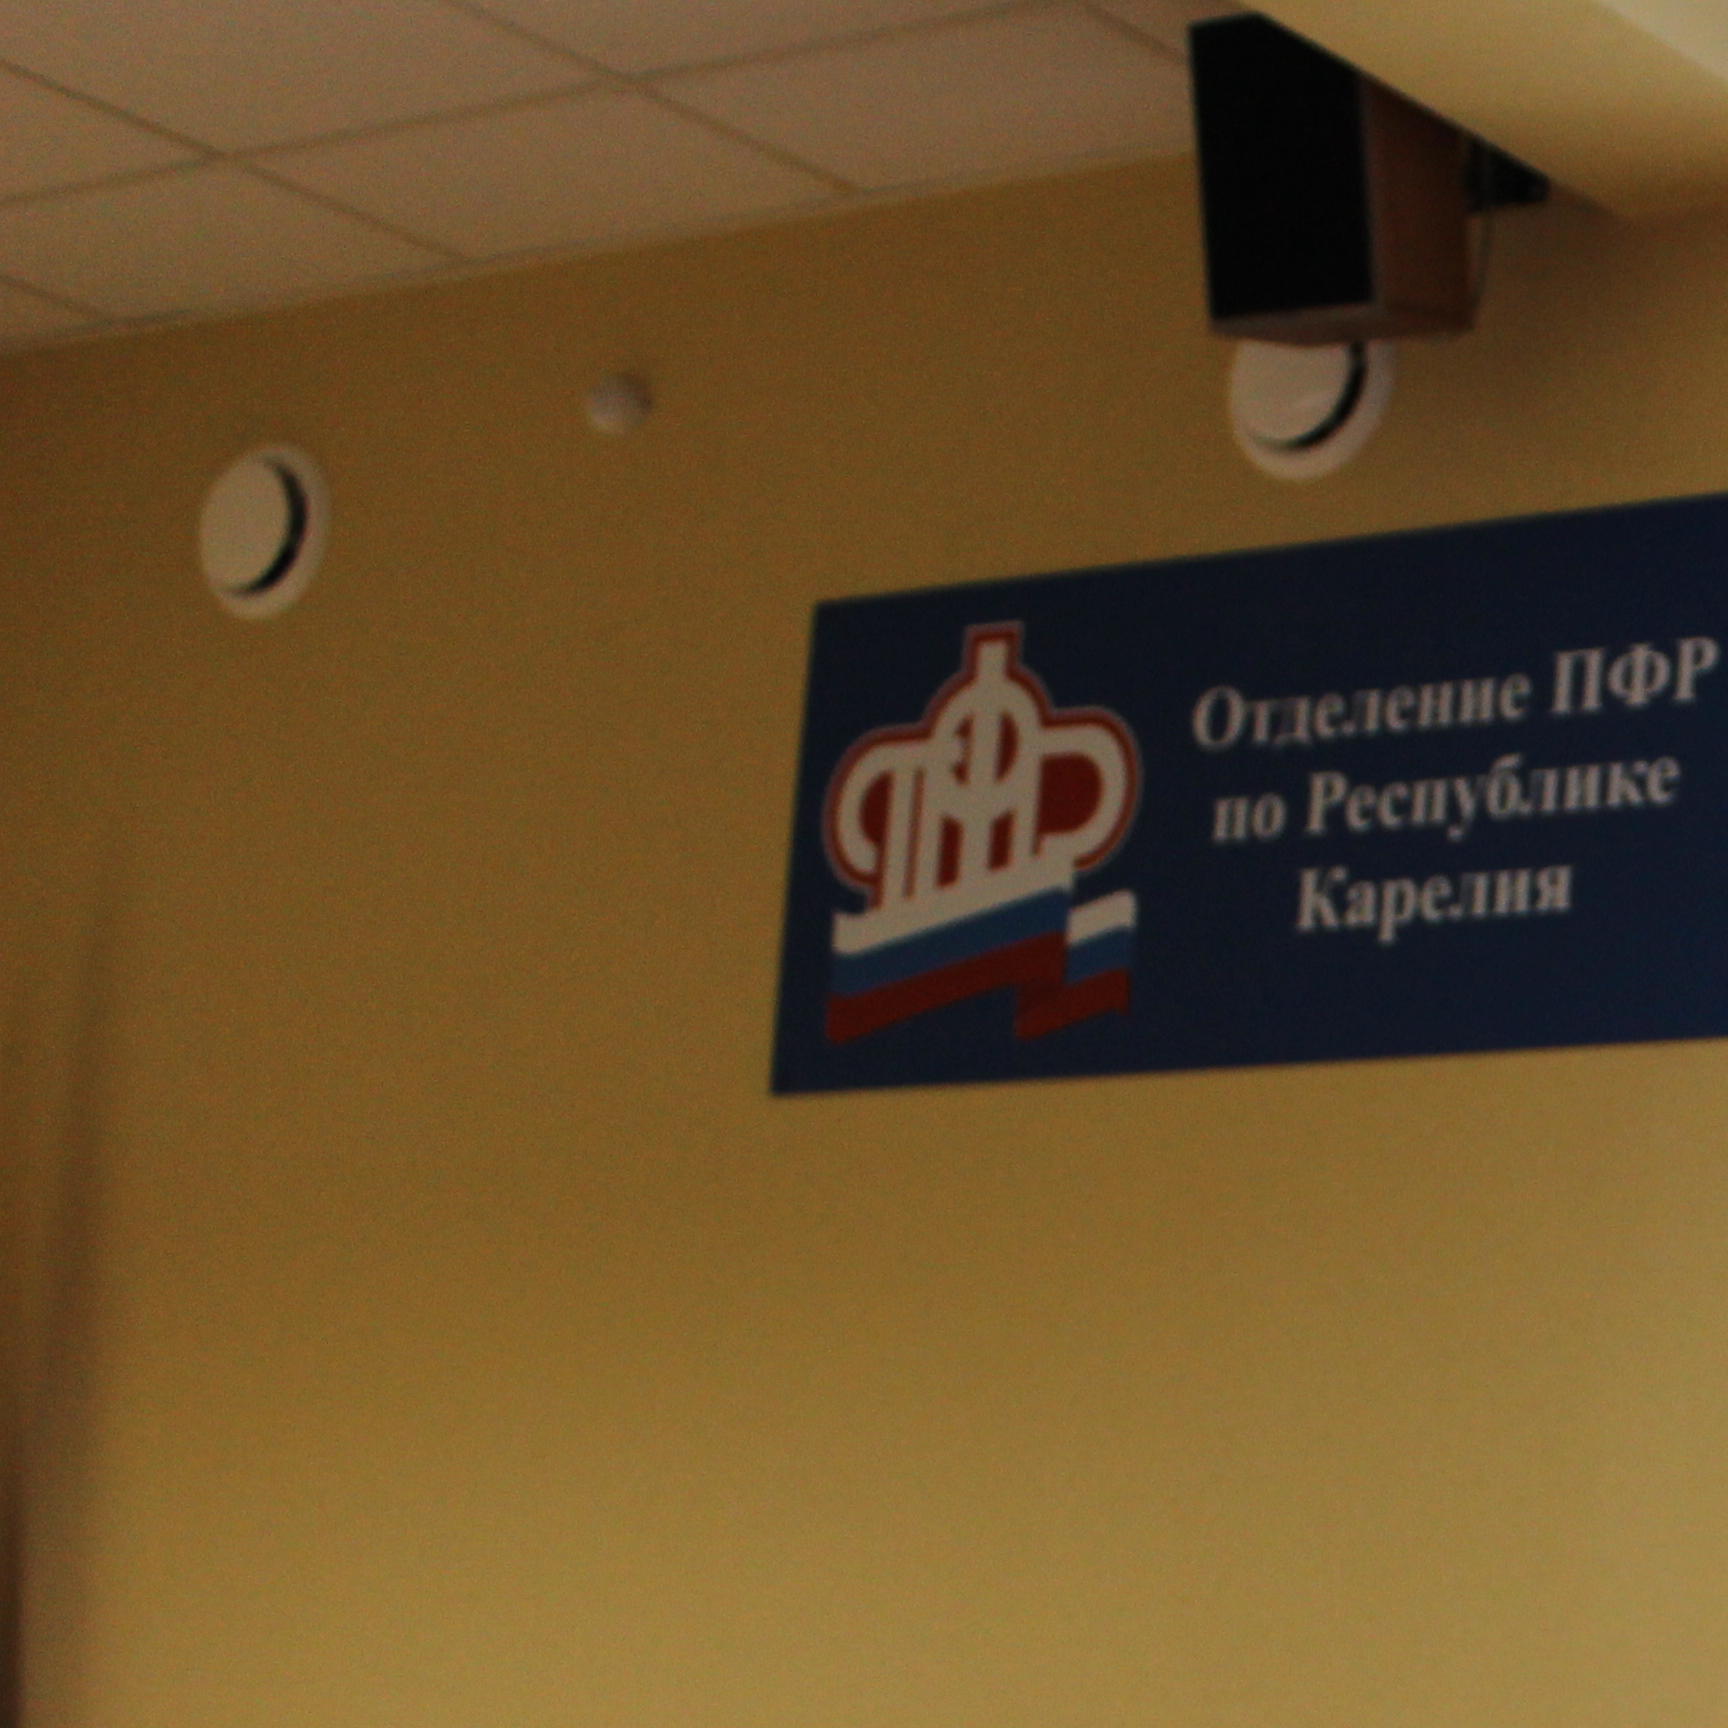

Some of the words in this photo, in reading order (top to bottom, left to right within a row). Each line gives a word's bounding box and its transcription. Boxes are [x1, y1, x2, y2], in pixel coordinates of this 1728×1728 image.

[1192, 665, 1531, 751] Отделение
[1550, 635, 1720, 718] ПФР
[1211, 783, 1286, 844] по
[1305, 753, 1682, 840] Республике
[1295, 863, 1574, 946] Карелия
